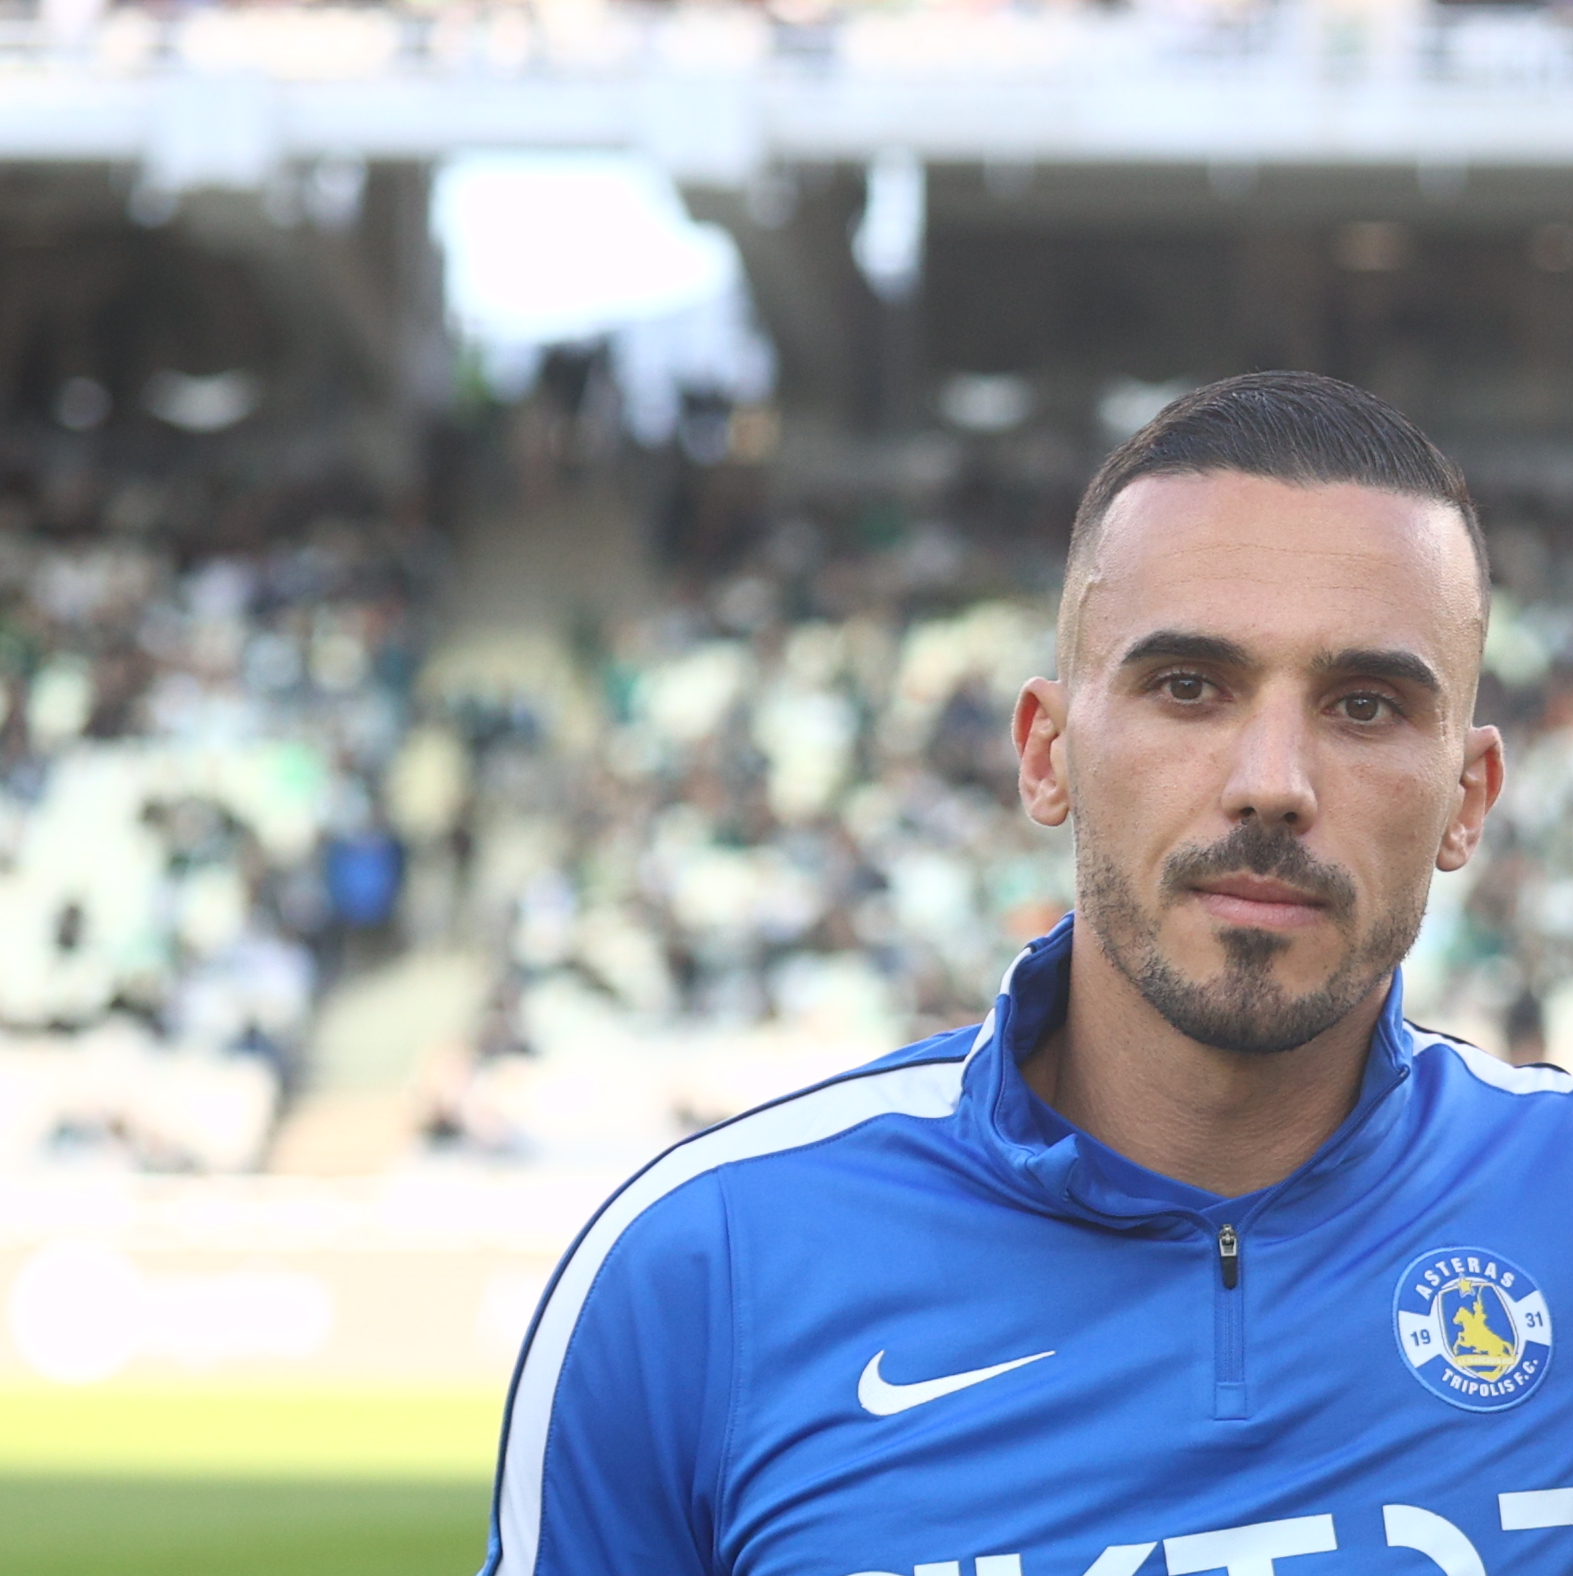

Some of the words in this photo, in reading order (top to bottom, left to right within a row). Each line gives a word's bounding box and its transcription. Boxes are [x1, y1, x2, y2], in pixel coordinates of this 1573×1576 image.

[1415, 1257, 1516, 1301] ASTERAS
[1524, 1311, 1544, 1329] 31
[1410, 1329, 1432, 1347] 19
[1441, 1368, 1516, 1397] TRIPOLIS
[1512, 1358, 1540, 1386] F.C.
